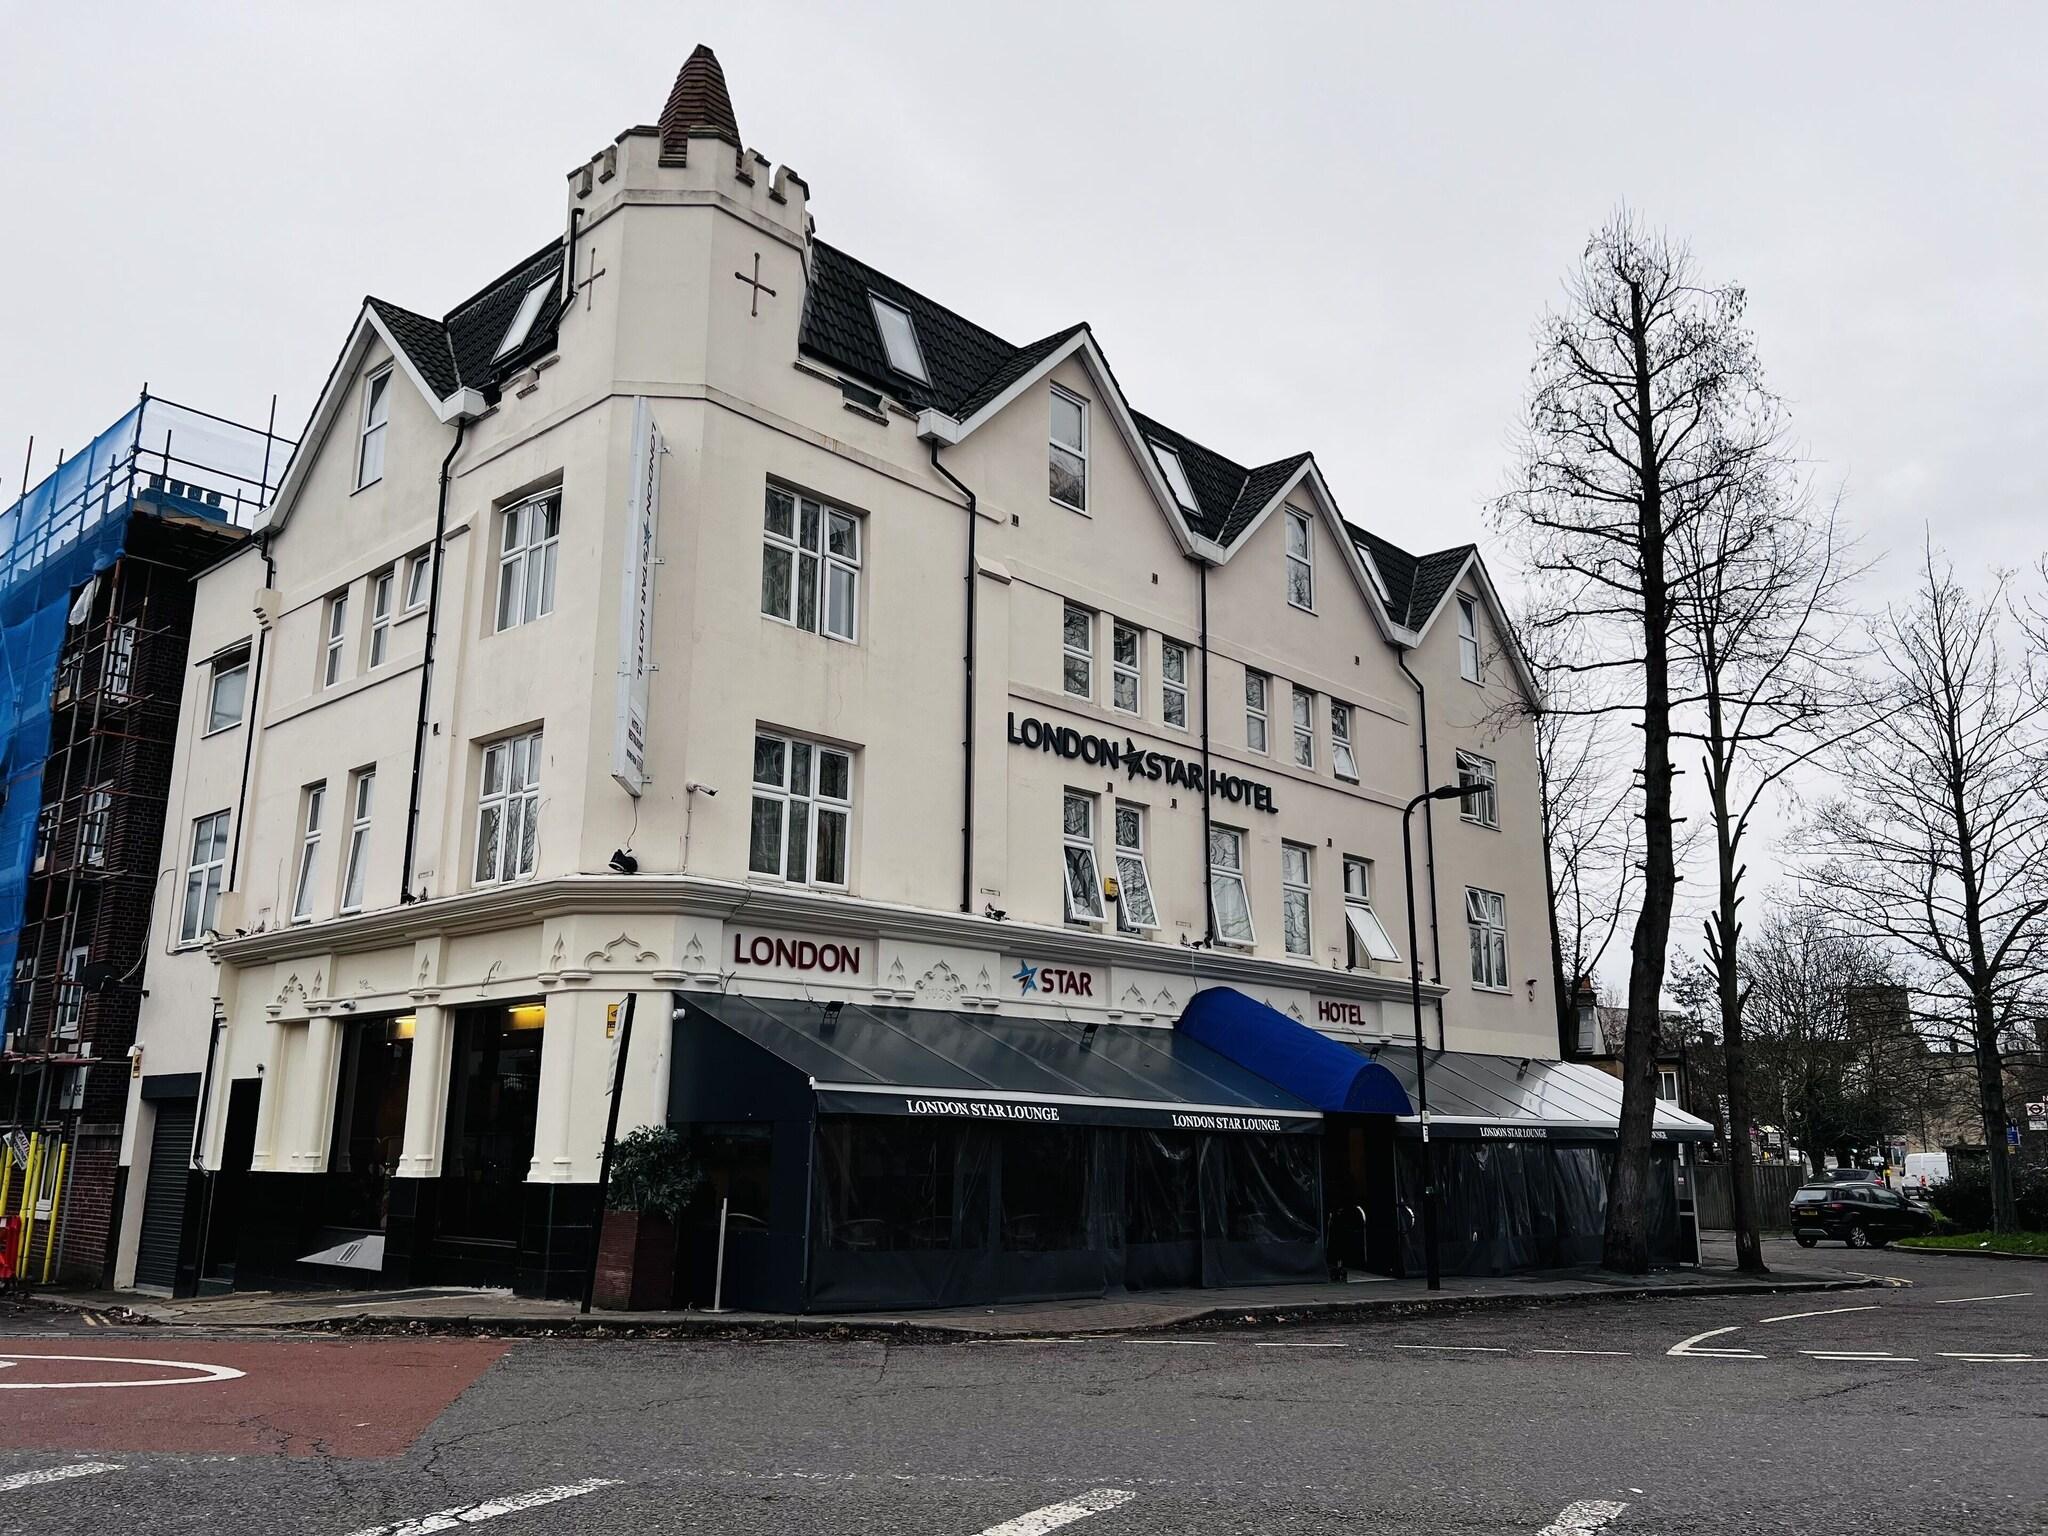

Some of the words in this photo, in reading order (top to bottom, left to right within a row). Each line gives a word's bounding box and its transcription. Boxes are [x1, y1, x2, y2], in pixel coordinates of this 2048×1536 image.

[645, 422, 657, 516] LONDON
[640, 541, 651, 605] STAR
[636, 608, 646, 680] HOTEL
[1008, 711, 1119, 770] LONDON
[1146, 752, 1204, 791] STAR
[1210, 769, 1279, 814] HOTEL
[734, 933, 860, 974] LONDON
[1041, 969, 1093, 996] STAR
[1318, 1000, 1366, 1026] HOTEL
[64, 1082, 82, 1096] HOSE
[906, 1100, 969, 1115] LONDON
[970, 1103, 1007, 1117] STAR
[1007, 1105, 1060, 1120] LOUNGE
[1172, 1114, 1215, 1128] LONDON
[1216, 1117, 1241, 1129] STAR
[1242, 1118, 1280, 1131] LOUNGE
[1480, 1127, 1507, 1137] LONDON
[1507, 1127, 1523, 1137] STAR
[1523, 1128, 1547, 1138] LOUNGE
